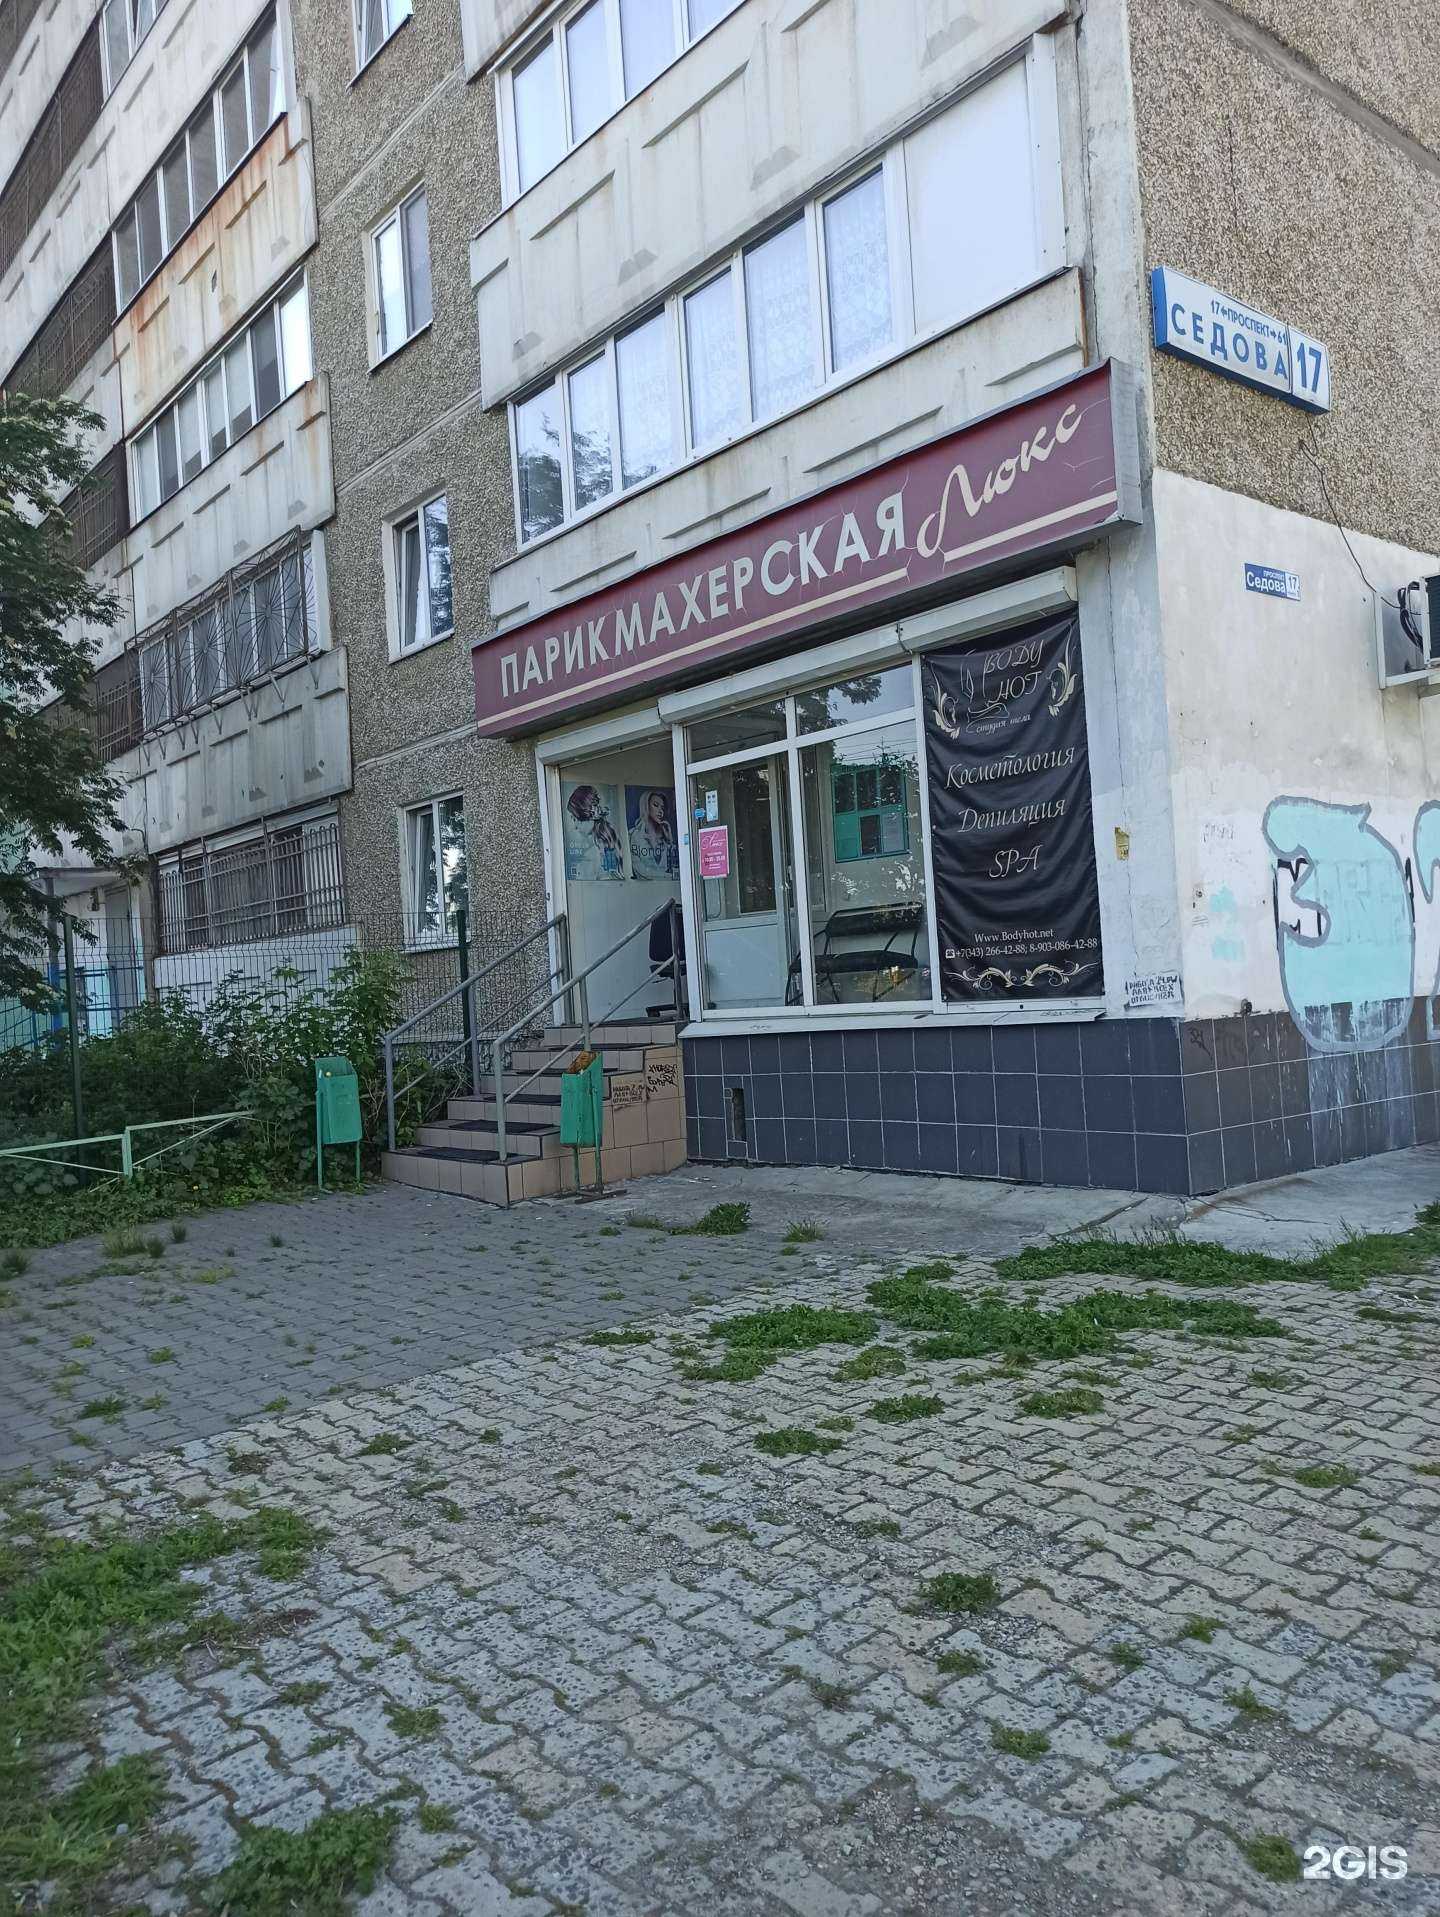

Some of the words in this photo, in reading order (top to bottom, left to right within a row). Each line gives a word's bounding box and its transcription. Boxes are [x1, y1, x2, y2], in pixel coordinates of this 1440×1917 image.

[1211, 299, 1221, 315] 17
[1227, 307, 1270, 338] ПРОСПЕКТ
[1277, 331, 1288, 345] 61
[1171, 302, 1288, 380] СЕДОВА
[1297, 342, 1322, 393] 17
[501, 491, 907, 698] ПАРИКМАХЕРСКАЯ
[917, 402, 1083, 559] Люкс
[1246, 571, 1286, 594] Седова
[984, 640, 1044, 674] BODY
[994, 670, 1043, 703] HOT
[944, 746, 1076, 790] Косметология
[957, 799, 1067, 833] Депиляция
[988, 845, 1043, 878] SPA
